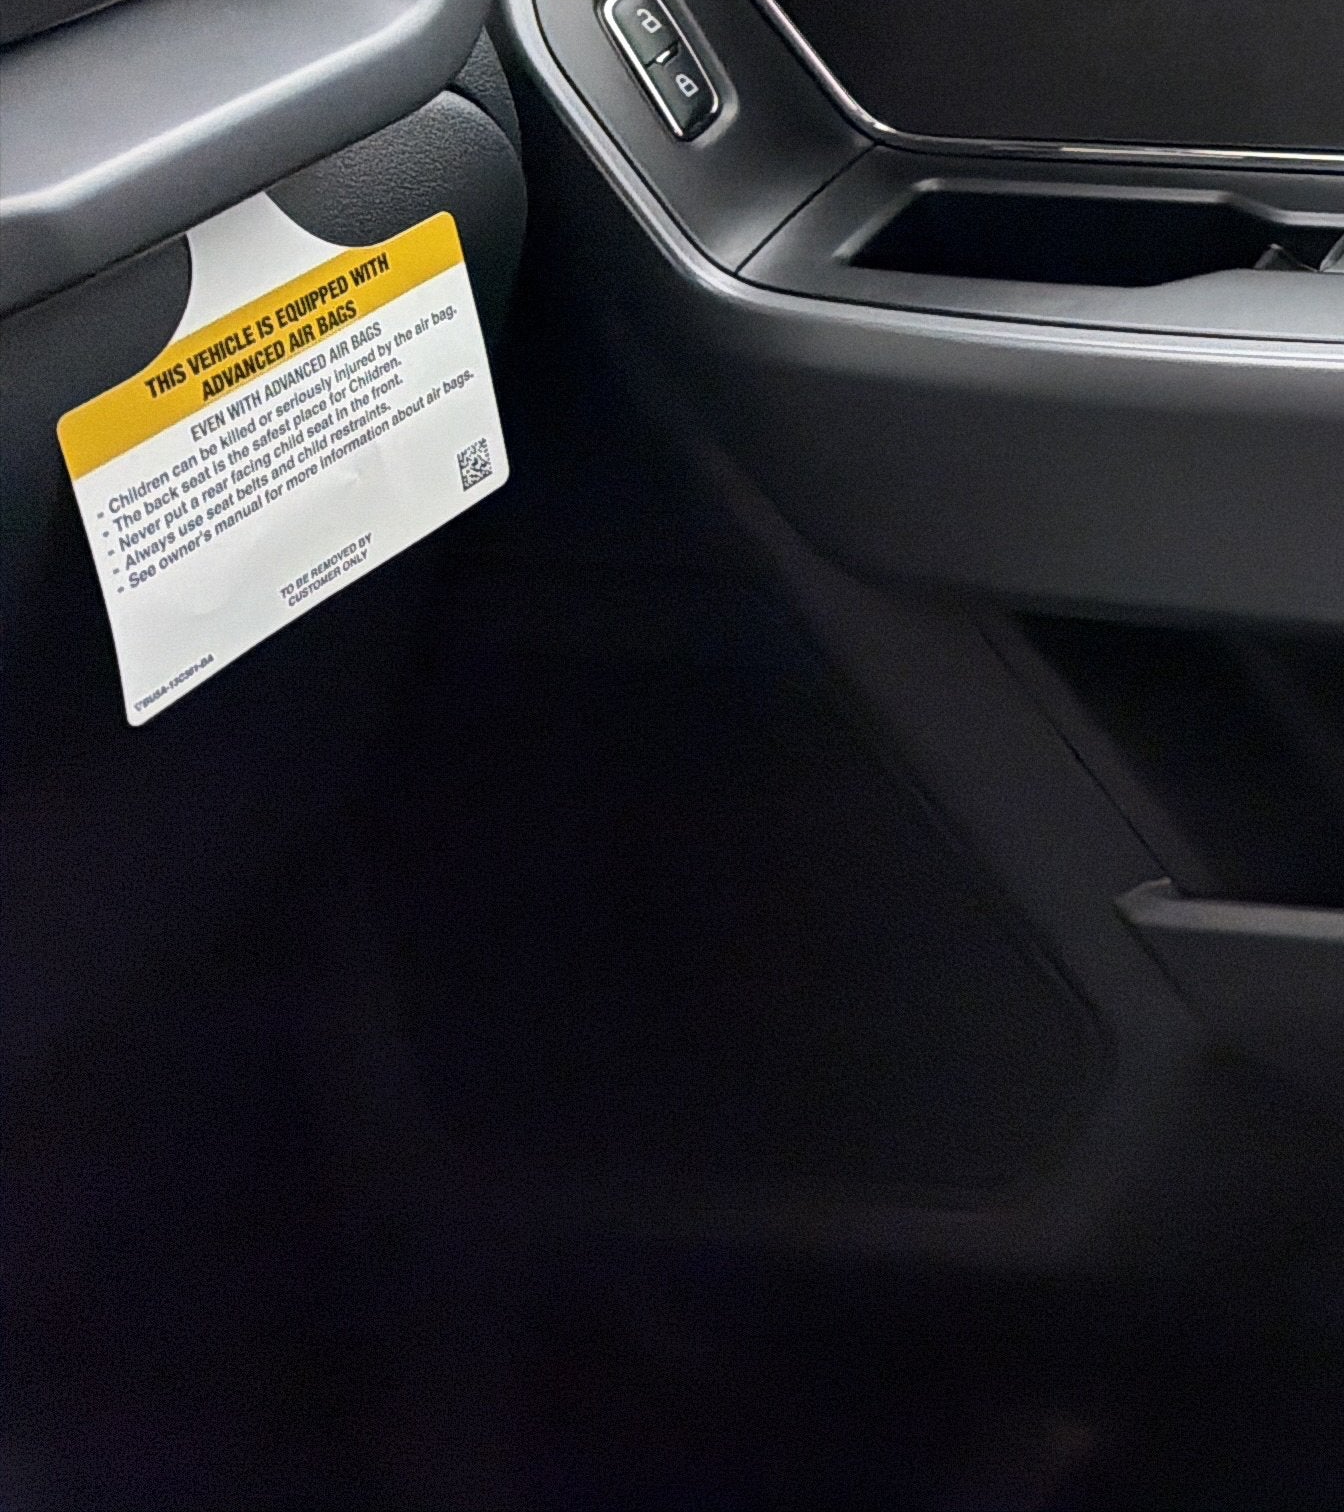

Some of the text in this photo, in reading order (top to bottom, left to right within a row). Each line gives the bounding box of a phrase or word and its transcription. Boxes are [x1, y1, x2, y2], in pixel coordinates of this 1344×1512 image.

[145, 253, 389, 398] THIS VEHICLE IS EQUIPPED WITH
[190, 321, 382, 443] EVEN WITH ADVANCED AIR BAGS
[202, 300, 357, 401] ADVANCED AIR BAGS
[108, 305, 458, 514] Children can be killed or seriously injured by the air bag.
[112, 357, 403, 533] The back seat is the safest place for Children.
[118, 373, 404, 553] Never put a rear facing child seat in the front.
[125, 402, 392, 571] Always use seat belts and child restraints.
[128, 369, 475, 589] See owner's manual for more information about air bags.
[279, 583, 295, 599] TO
[310, 542, 358, 579] REMOVED
[288, 548, 368, 607] CUSTOMER ONLY
